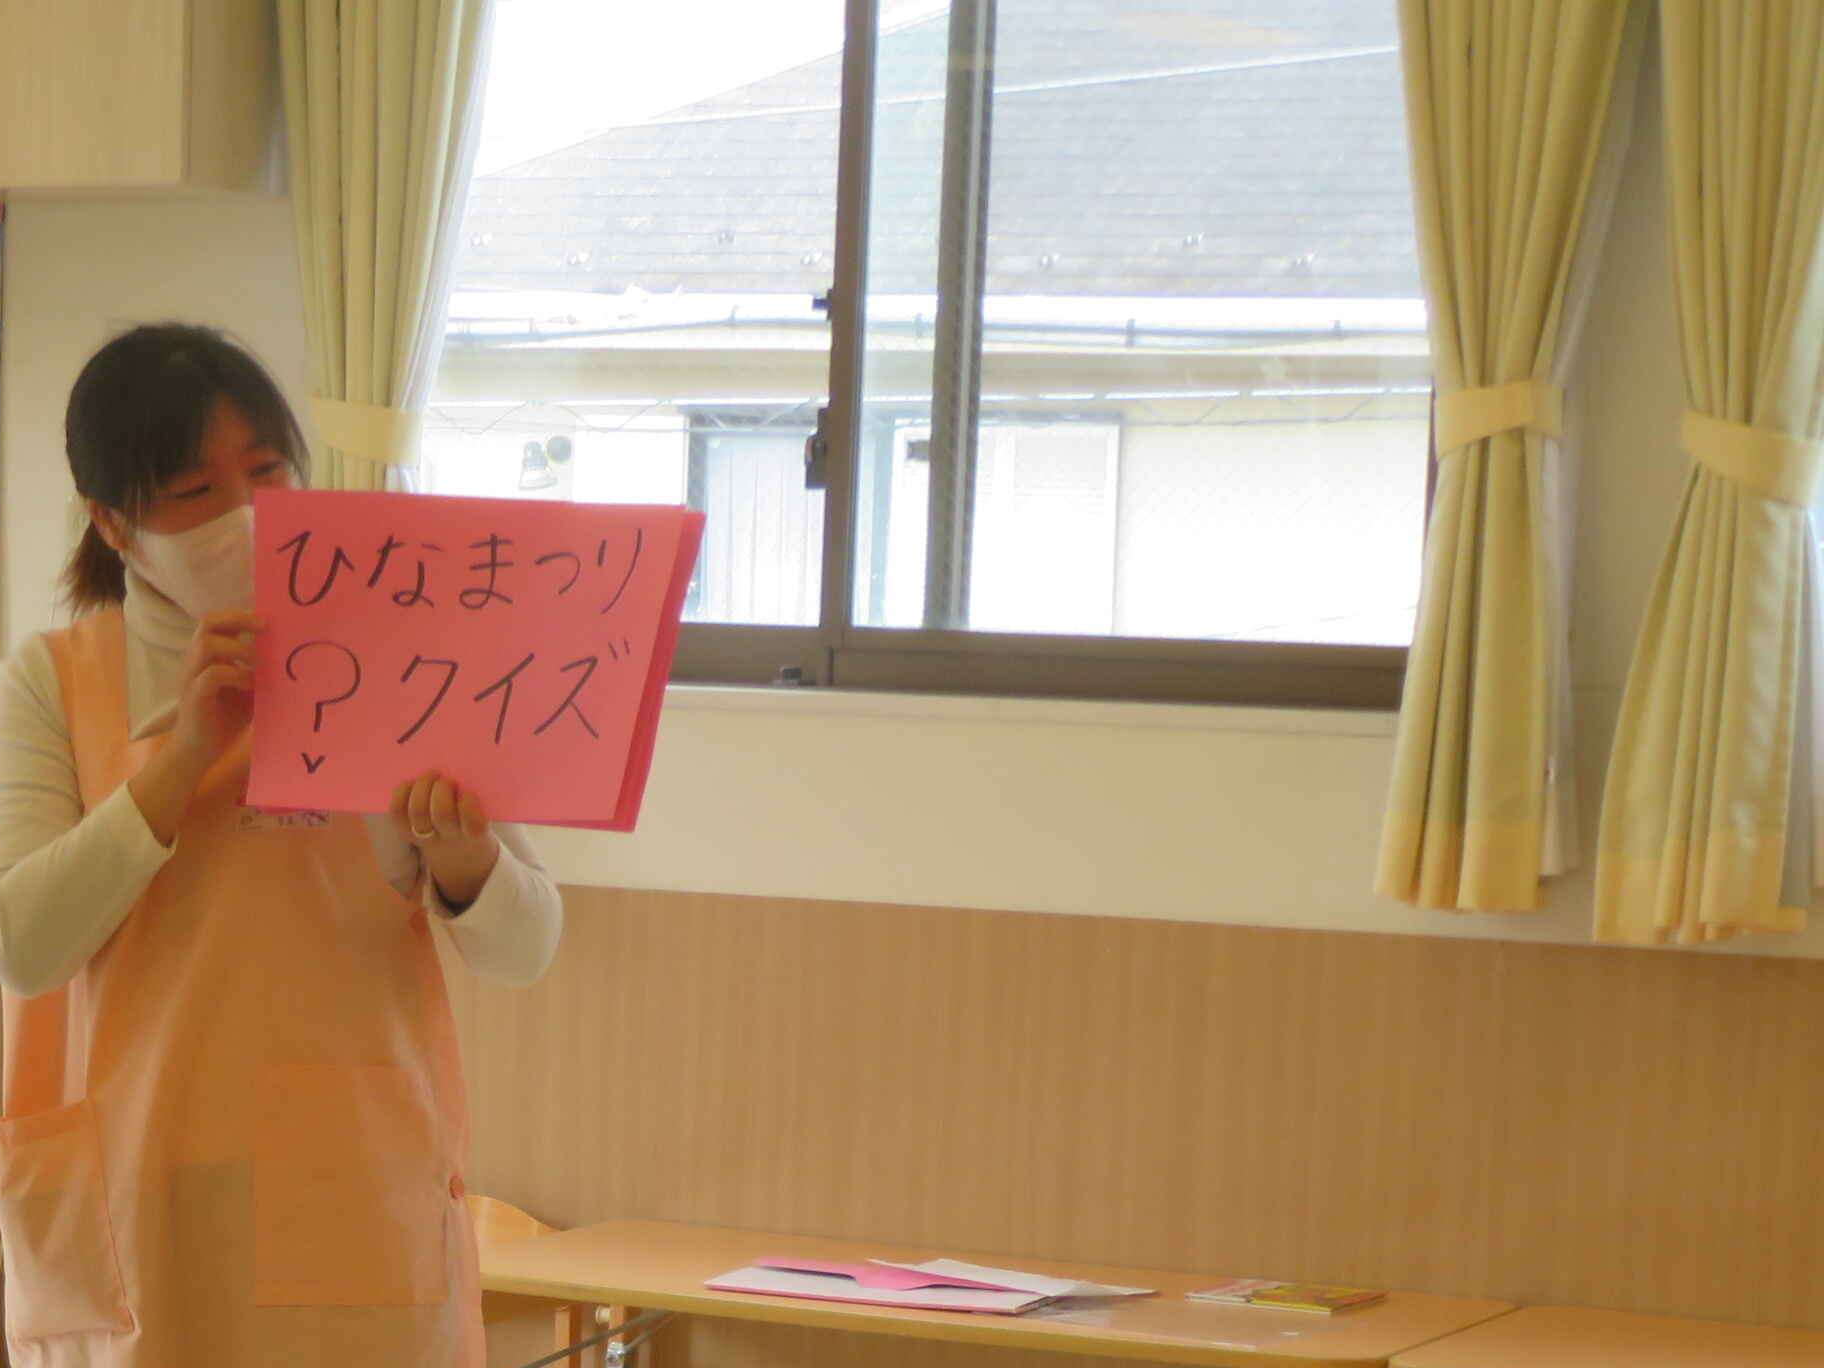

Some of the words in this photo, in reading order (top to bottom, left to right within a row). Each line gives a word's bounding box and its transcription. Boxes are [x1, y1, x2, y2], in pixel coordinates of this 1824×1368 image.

[277, 528, 642, 614] ひなまつり
